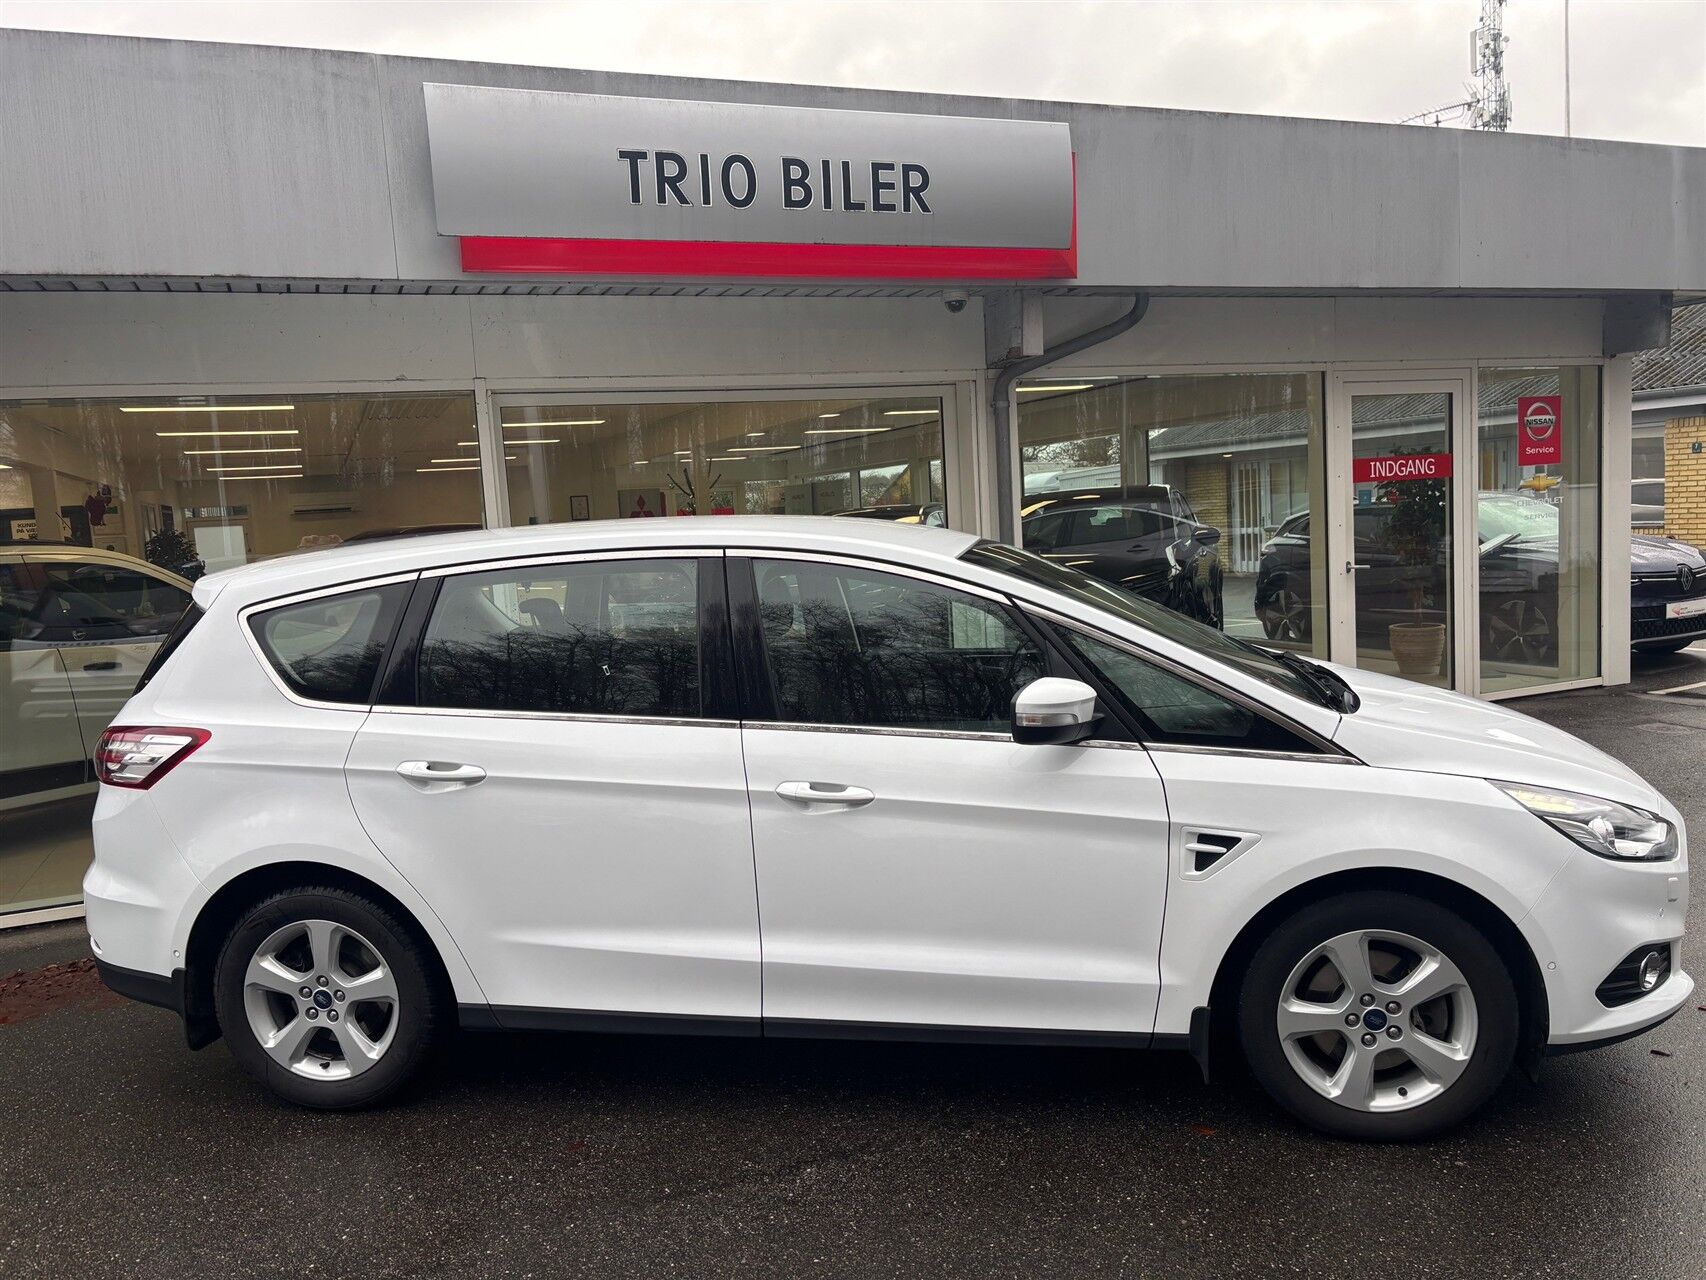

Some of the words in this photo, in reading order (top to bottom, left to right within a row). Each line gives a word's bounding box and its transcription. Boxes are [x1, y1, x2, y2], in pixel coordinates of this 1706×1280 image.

[617, 147, 758, 210] TRIO
[780, 155, 934, 215] BILER
[1525, 417, 1555, 426] NISSAN
[1525, 446, 1555, 455] Service
[1369, 458, 1436, 478] INDGANG
[1516, 496, 1564, 507] CHEVROLET
